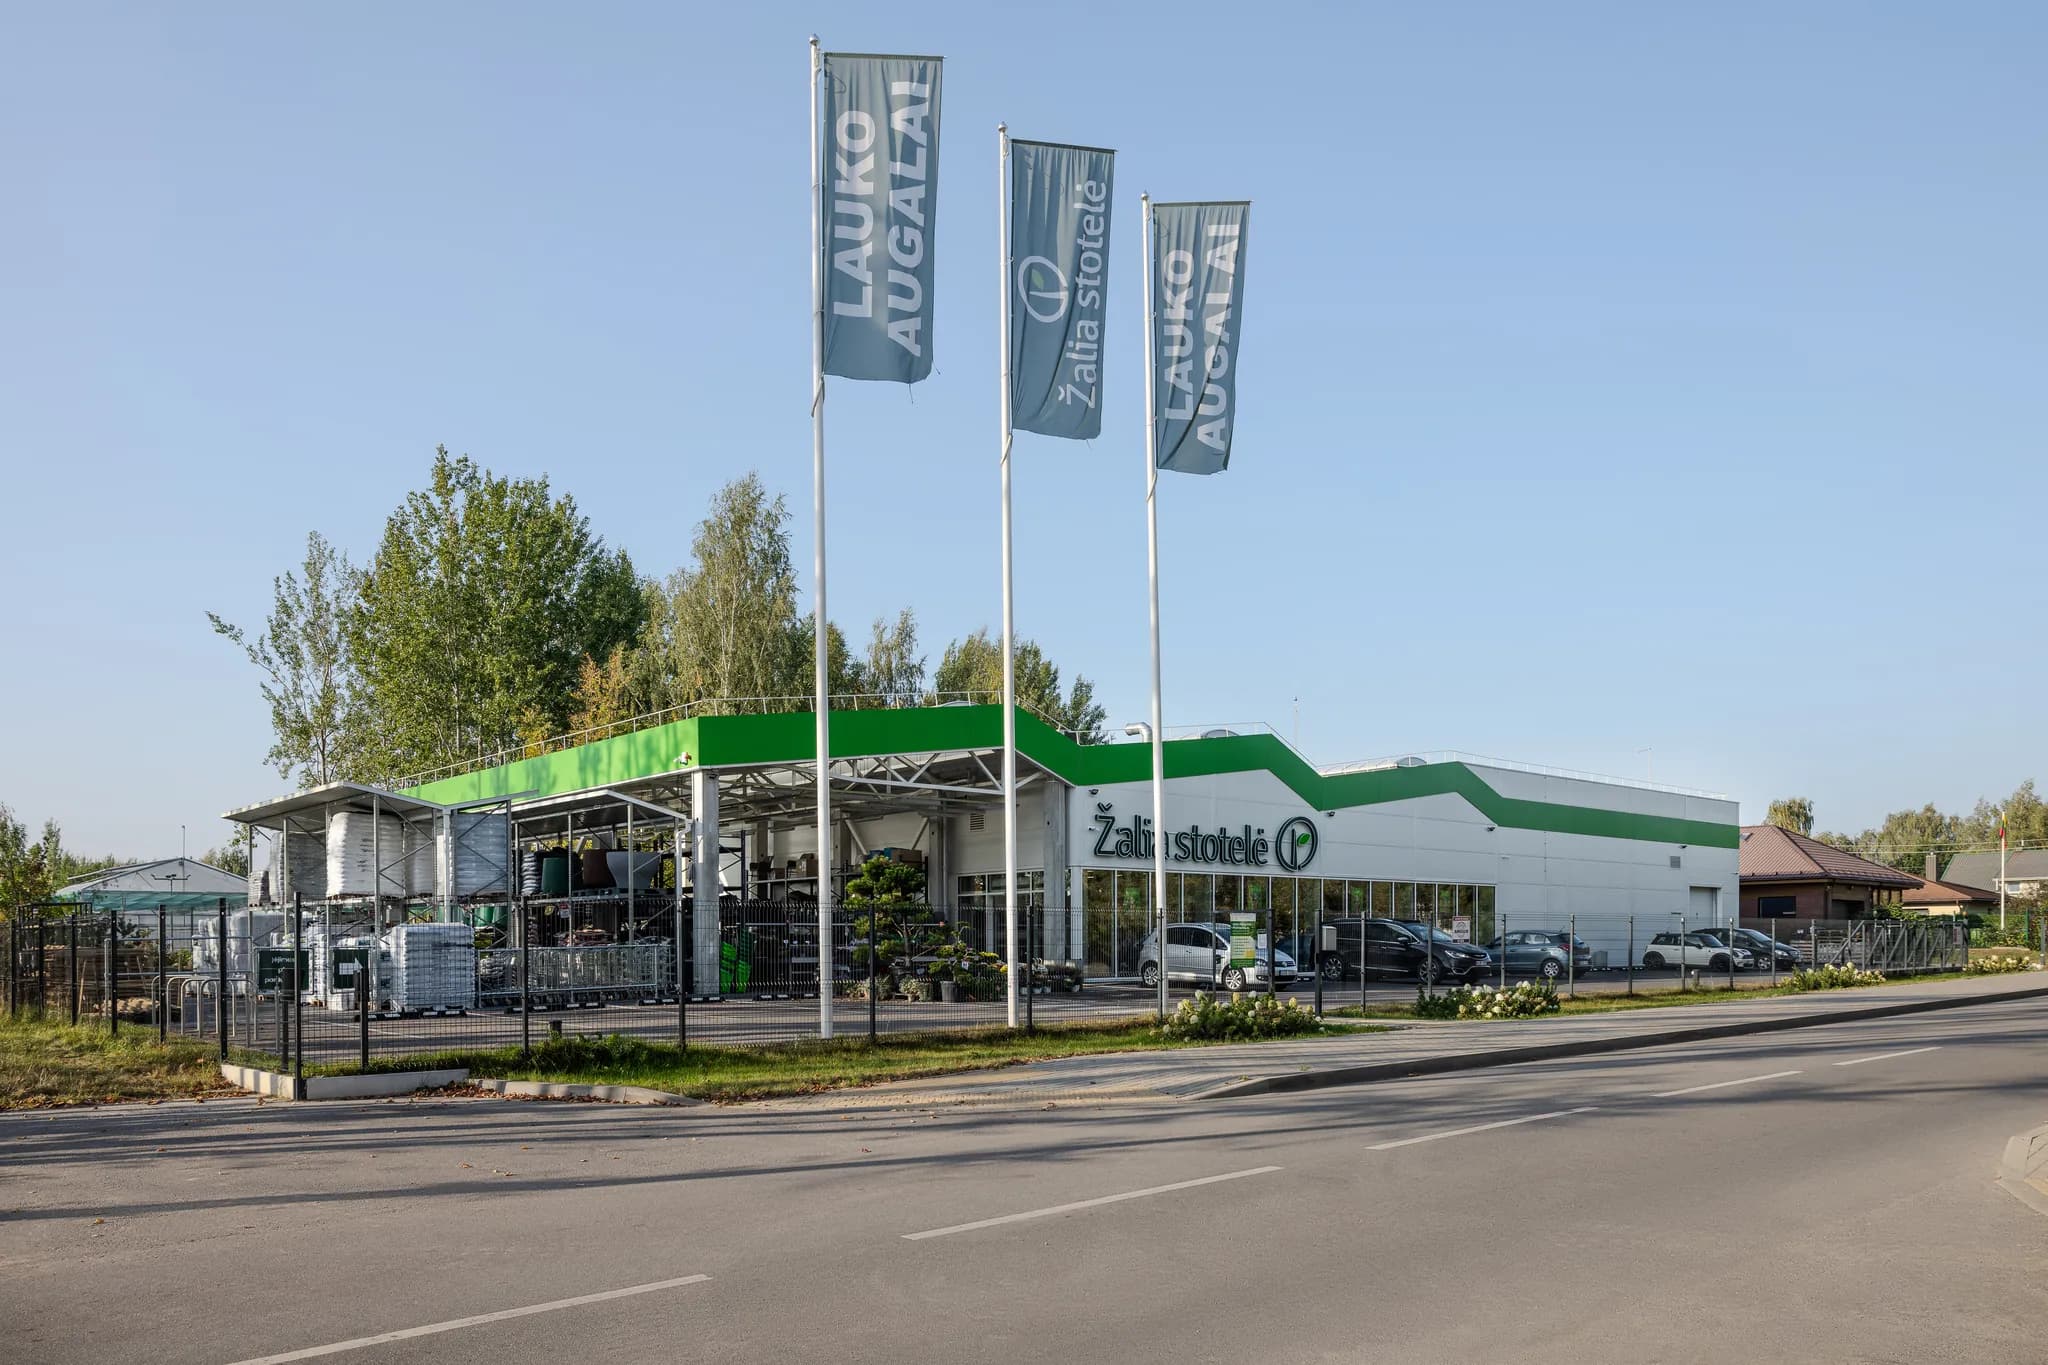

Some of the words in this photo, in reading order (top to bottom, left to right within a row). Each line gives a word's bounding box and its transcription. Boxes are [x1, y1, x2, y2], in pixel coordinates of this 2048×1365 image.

[833, 110, 875, 318] LAUKO
[886, 80, 930, 357] AUGALAI
[1073, 178, 1107, 310] stotelė
[1059, 323, 1099, 409] Žalia
[1164, 249, 1194, 421] LAUKO
[1197, 223, 1239, 450] AUGALAI
[1174, 824, 1269, 866] stotelė
